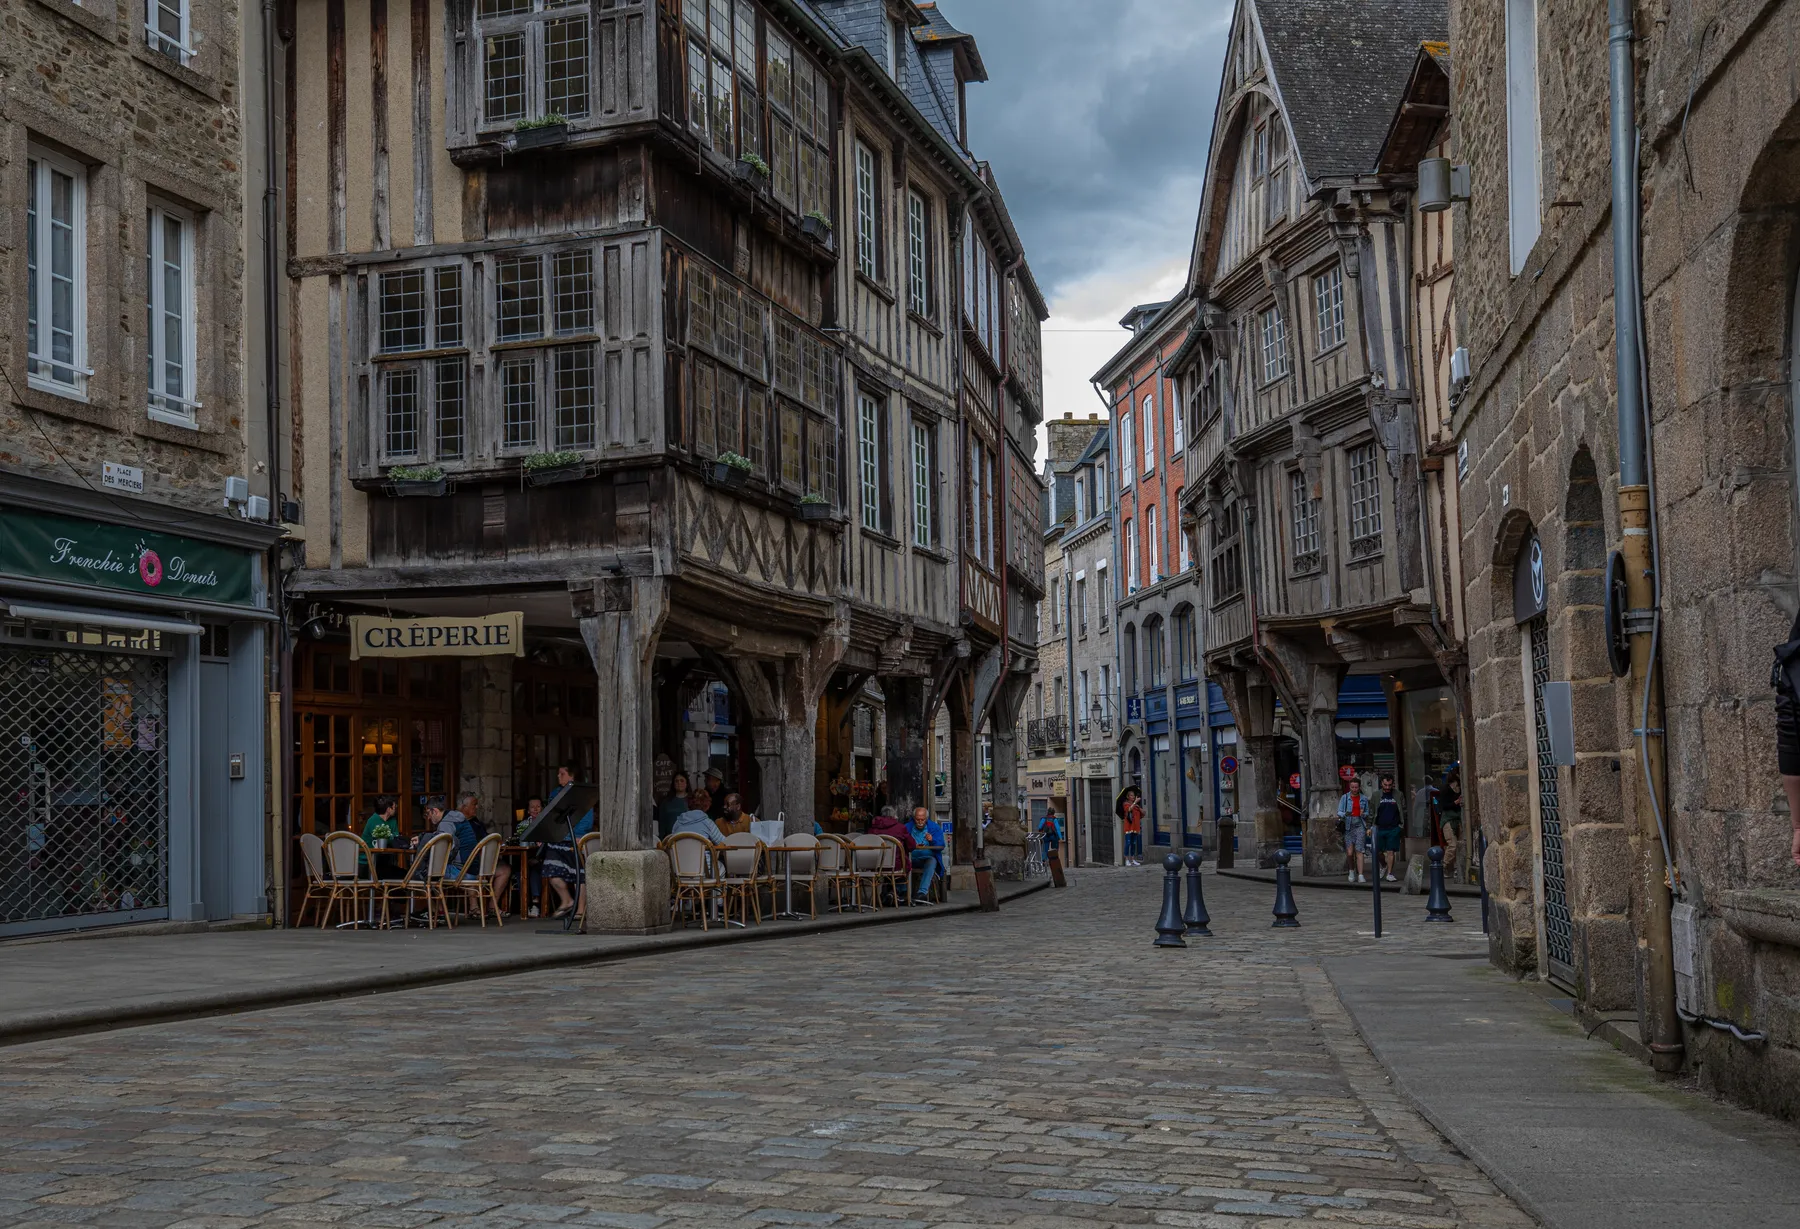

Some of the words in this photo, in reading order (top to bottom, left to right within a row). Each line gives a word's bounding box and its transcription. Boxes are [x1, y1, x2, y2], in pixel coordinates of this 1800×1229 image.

[117, 467, 131, 476] PLACE
[104, 475, 114, 484] DES
[118, 478, 142, 489] MERCIERS
[167, 556, 219, 587] Donuts
[364, 622, 511, 649] CRÊPERIE
